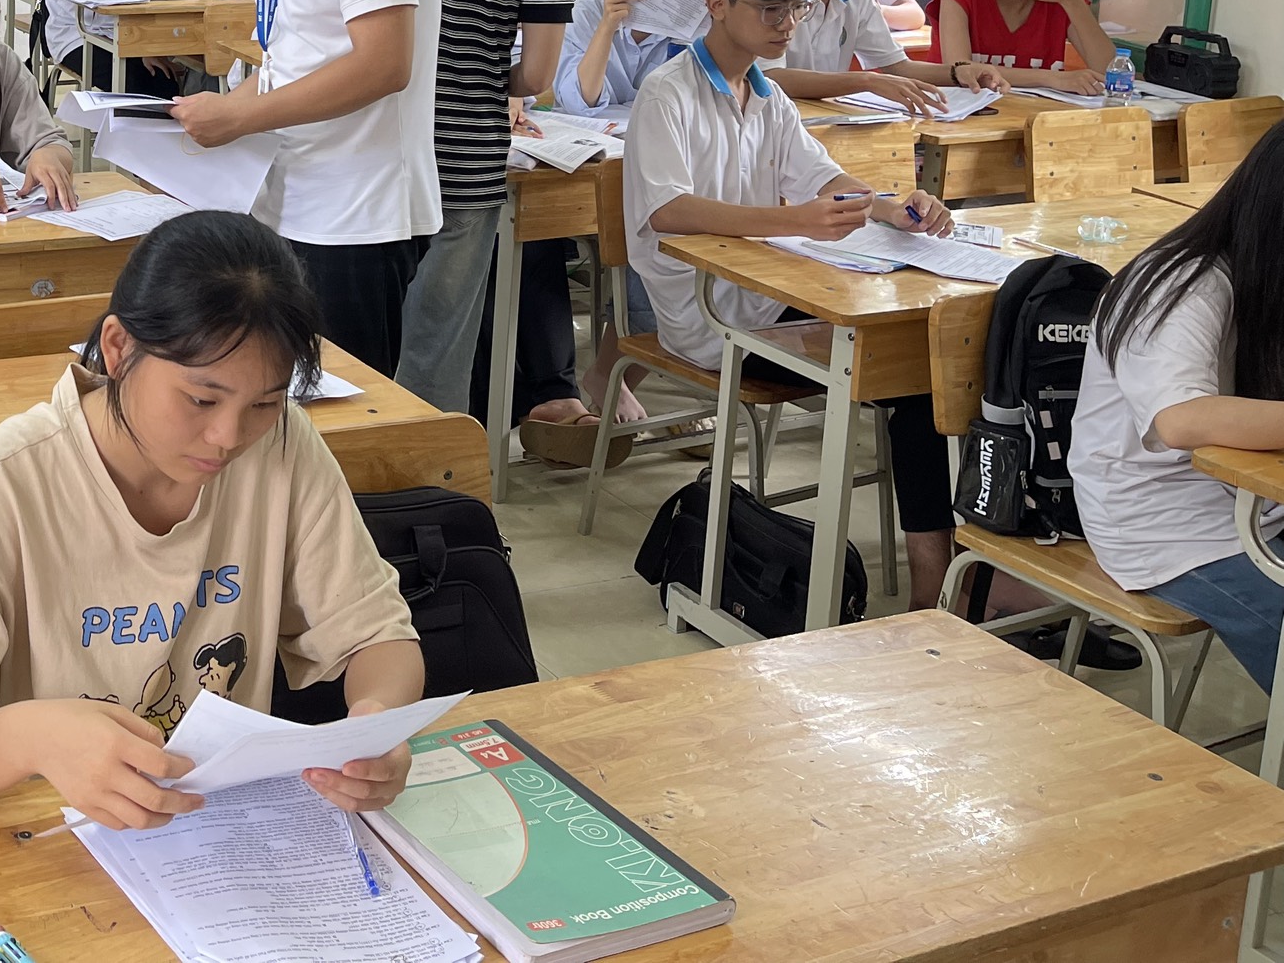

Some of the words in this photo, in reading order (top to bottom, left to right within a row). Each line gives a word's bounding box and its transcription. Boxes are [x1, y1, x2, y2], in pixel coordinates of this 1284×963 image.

[81, 565, 241, 647] PEANTS
[480, 746, 509, 761] A4
[609, 885, 700, 914] Composition
[531, 918, 564, 930] 360tr
[569, 909, 612, 924] Book
